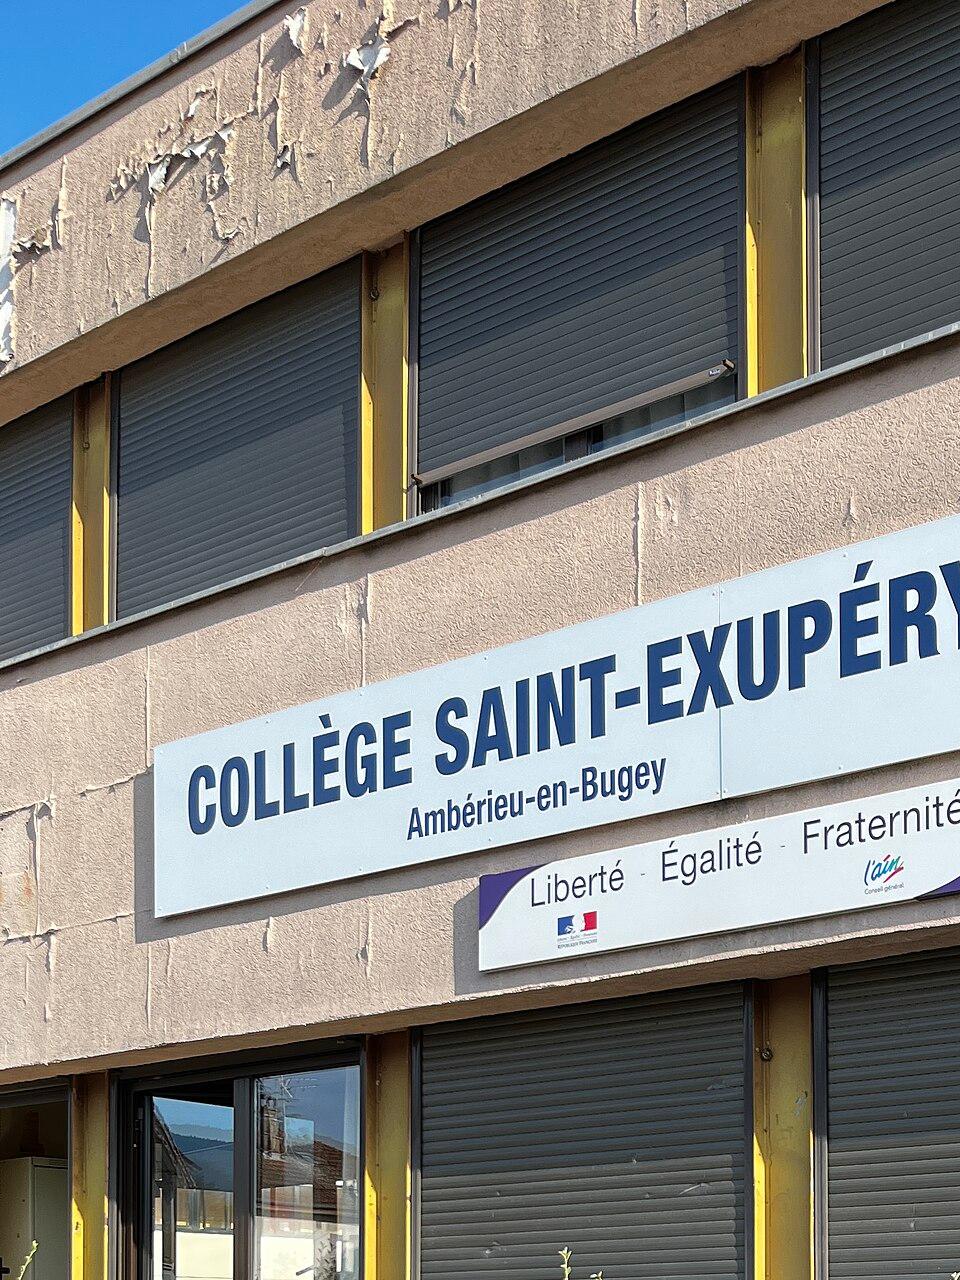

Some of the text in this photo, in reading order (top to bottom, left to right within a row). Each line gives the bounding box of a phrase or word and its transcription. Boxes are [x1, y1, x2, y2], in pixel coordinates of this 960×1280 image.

[187, 710, 413, 836] COLLÈGE
[406, 757, 667, 841] Ambérieu-en-Bugey
[531, 859, 624, 908] Liberté
[661, 831, 762, 886] Égalité
